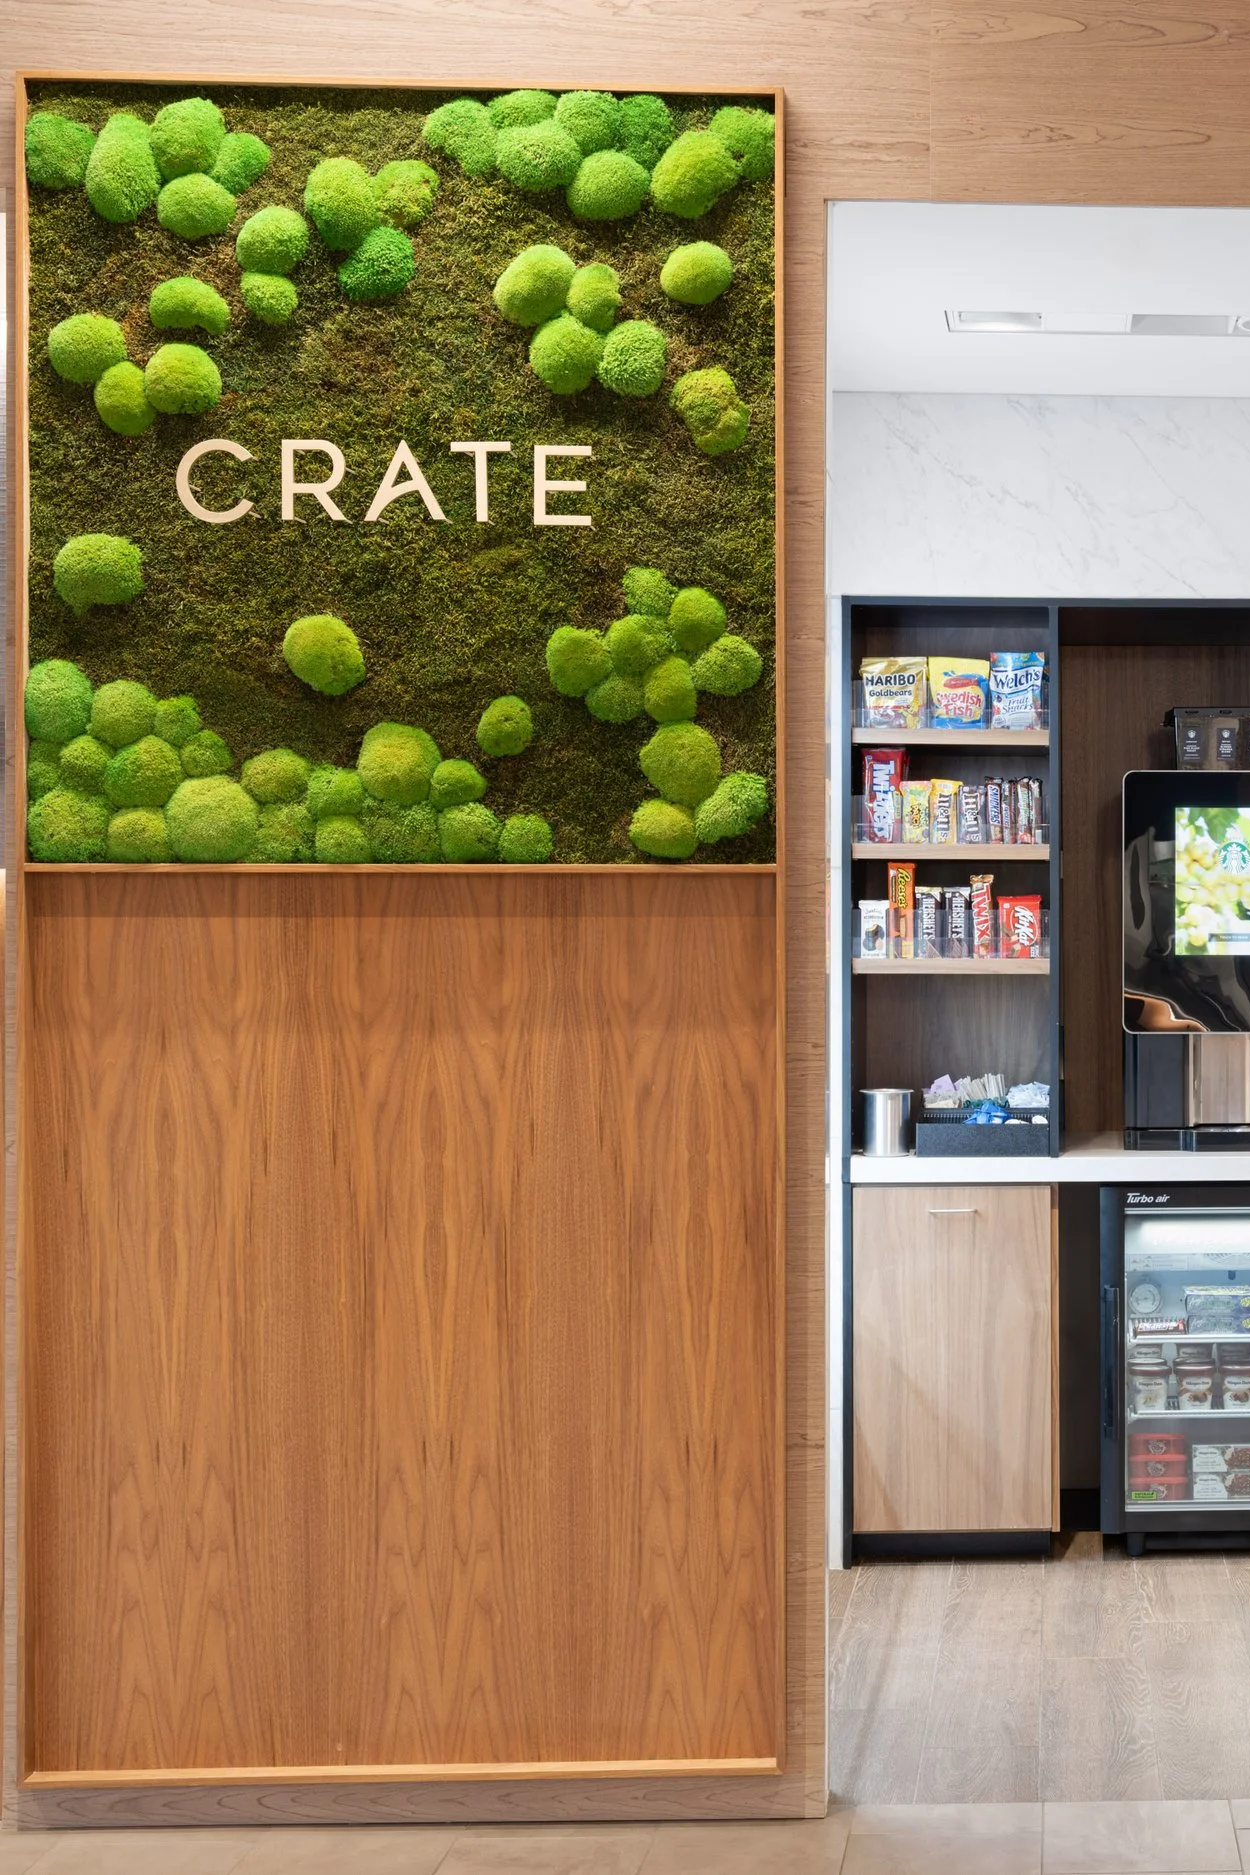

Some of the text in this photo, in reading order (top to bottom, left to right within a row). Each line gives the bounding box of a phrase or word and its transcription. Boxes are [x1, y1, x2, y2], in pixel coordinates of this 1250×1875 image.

[175, 438, 592, 526] CRATE
[865, 674, 915, 686] HARIBO
[992, 669, 1041, 690] Welch's
[869, 689, 912, 697] Goldbears
[936, 692, 982, 707] Swedish
[943, 703, 973, 717] Fish
[989, 786, 1000, 825] SNICKERS
[897, 868, 911, 908] Reese's
[971, 884, 991, 941] TWIX
[1126, 1192, 1170, 1203] Turbo air
